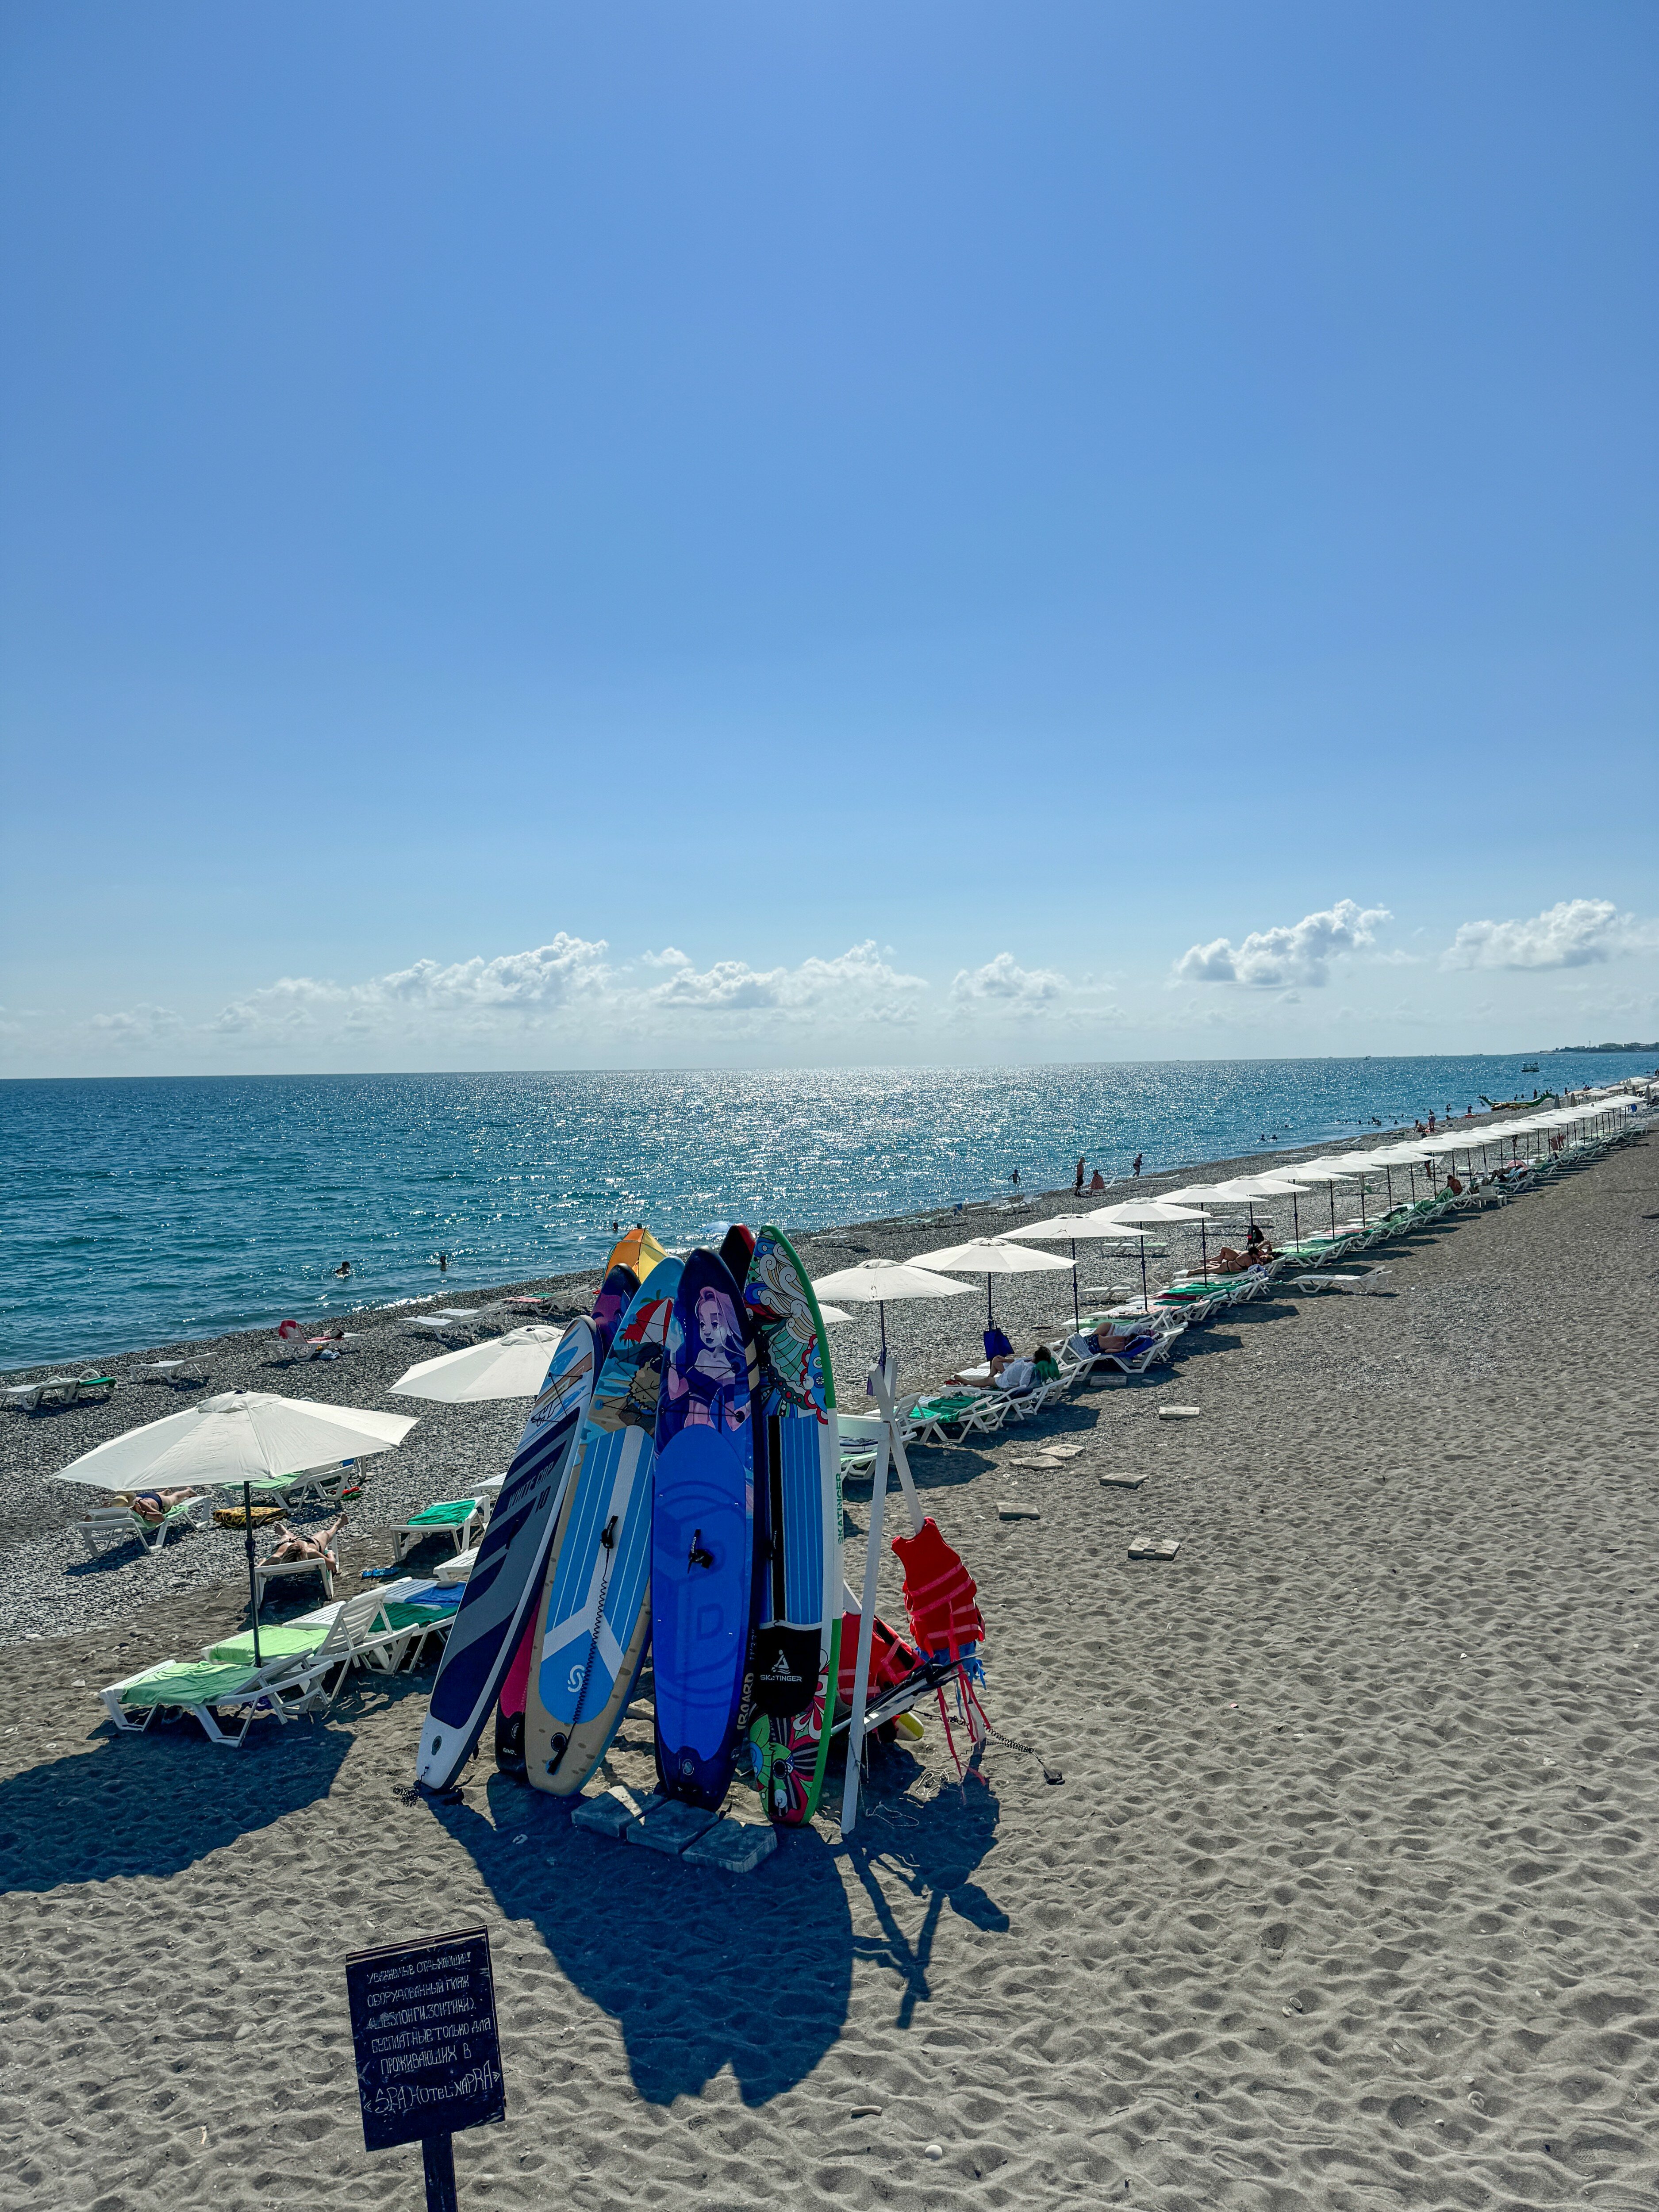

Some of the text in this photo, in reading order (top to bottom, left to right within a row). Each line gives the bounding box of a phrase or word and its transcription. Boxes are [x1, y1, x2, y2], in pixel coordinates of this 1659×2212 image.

[535, 1486, 551, 1513] 10
[368, 1975, 469, 2007] ОБОРУДОВАННЫЙ ПЛЯЖ
[433, 2023, 469, 2041] ТОЛЬКО
[472, 2017, 491, 2034] ДЛЯ
[381, 2043, 471, 2074] ПРОЖИВАЮЩИХ В
